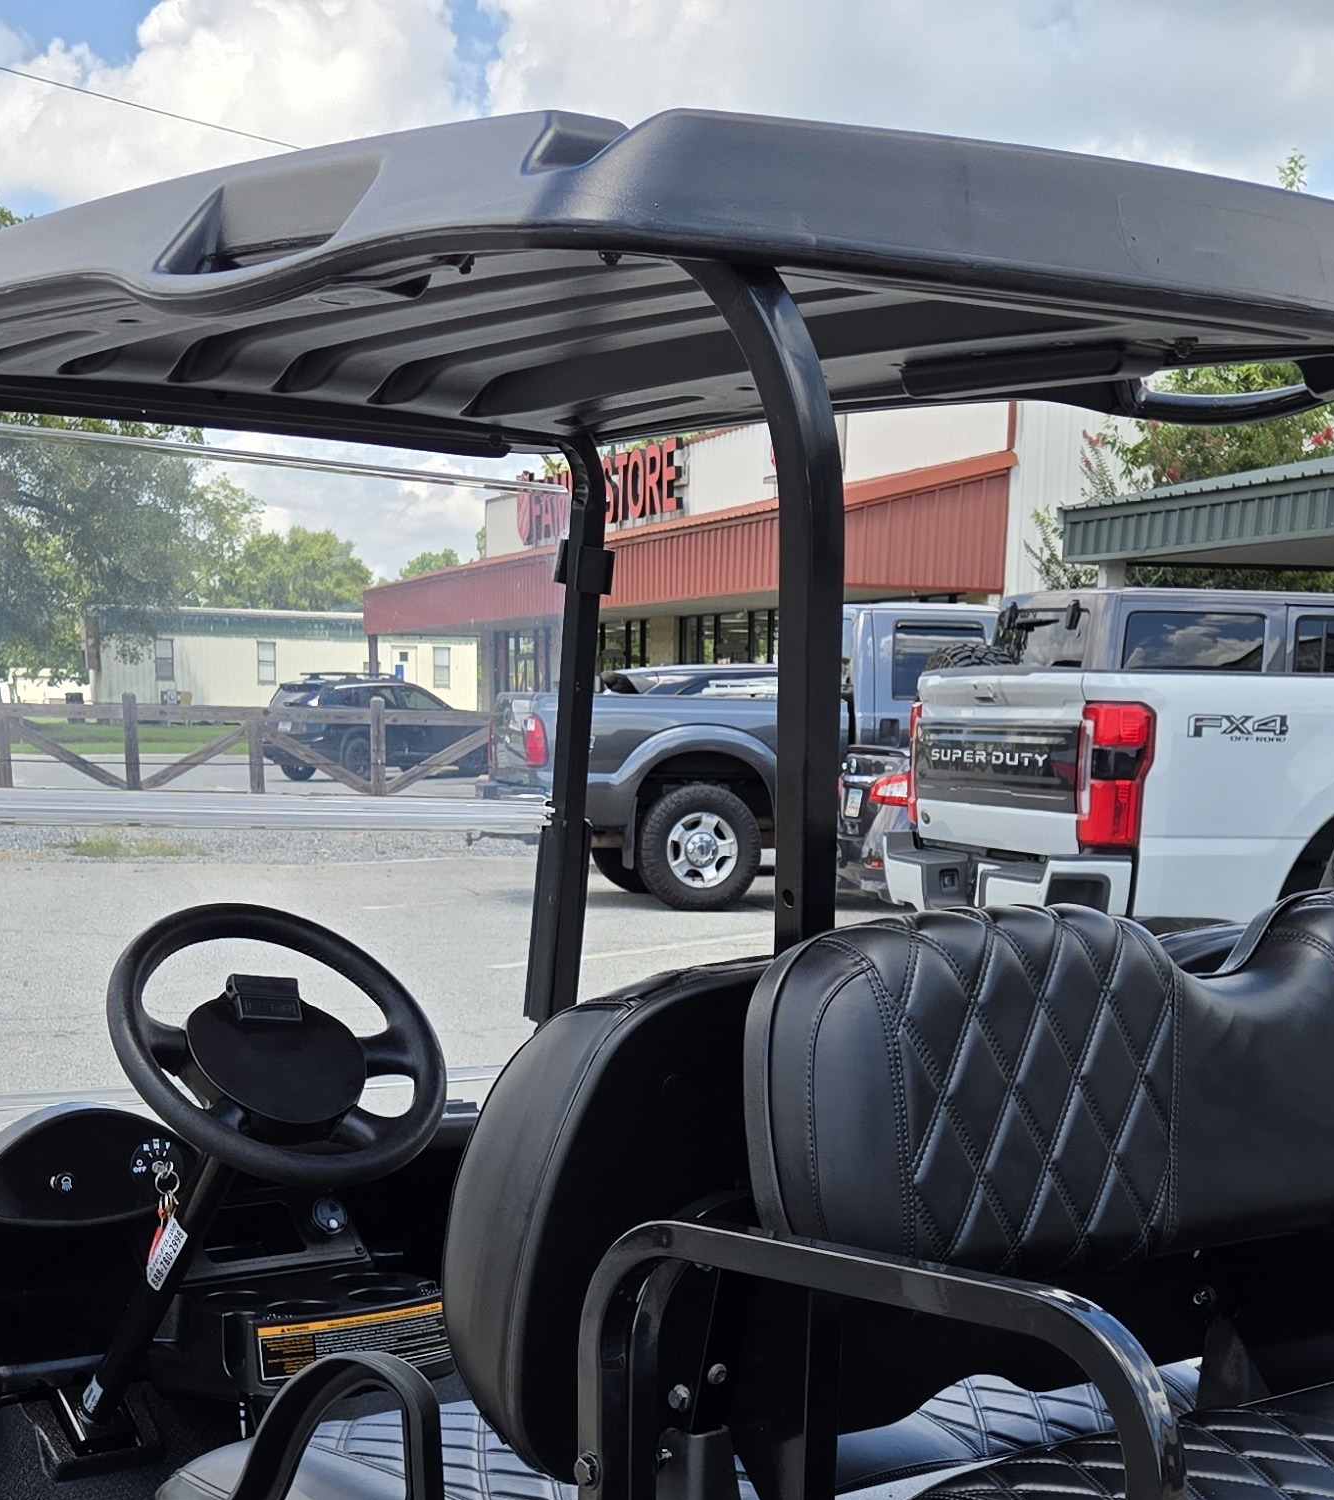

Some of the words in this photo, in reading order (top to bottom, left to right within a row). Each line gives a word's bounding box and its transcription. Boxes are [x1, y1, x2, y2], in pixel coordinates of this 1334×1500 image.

[603, 438, 677, 523] STORE
[1187, 714, 1289, 738] FX4
[931, 748, 987, 763] SUPER
[992, 751, 1048, 767] DUTY
